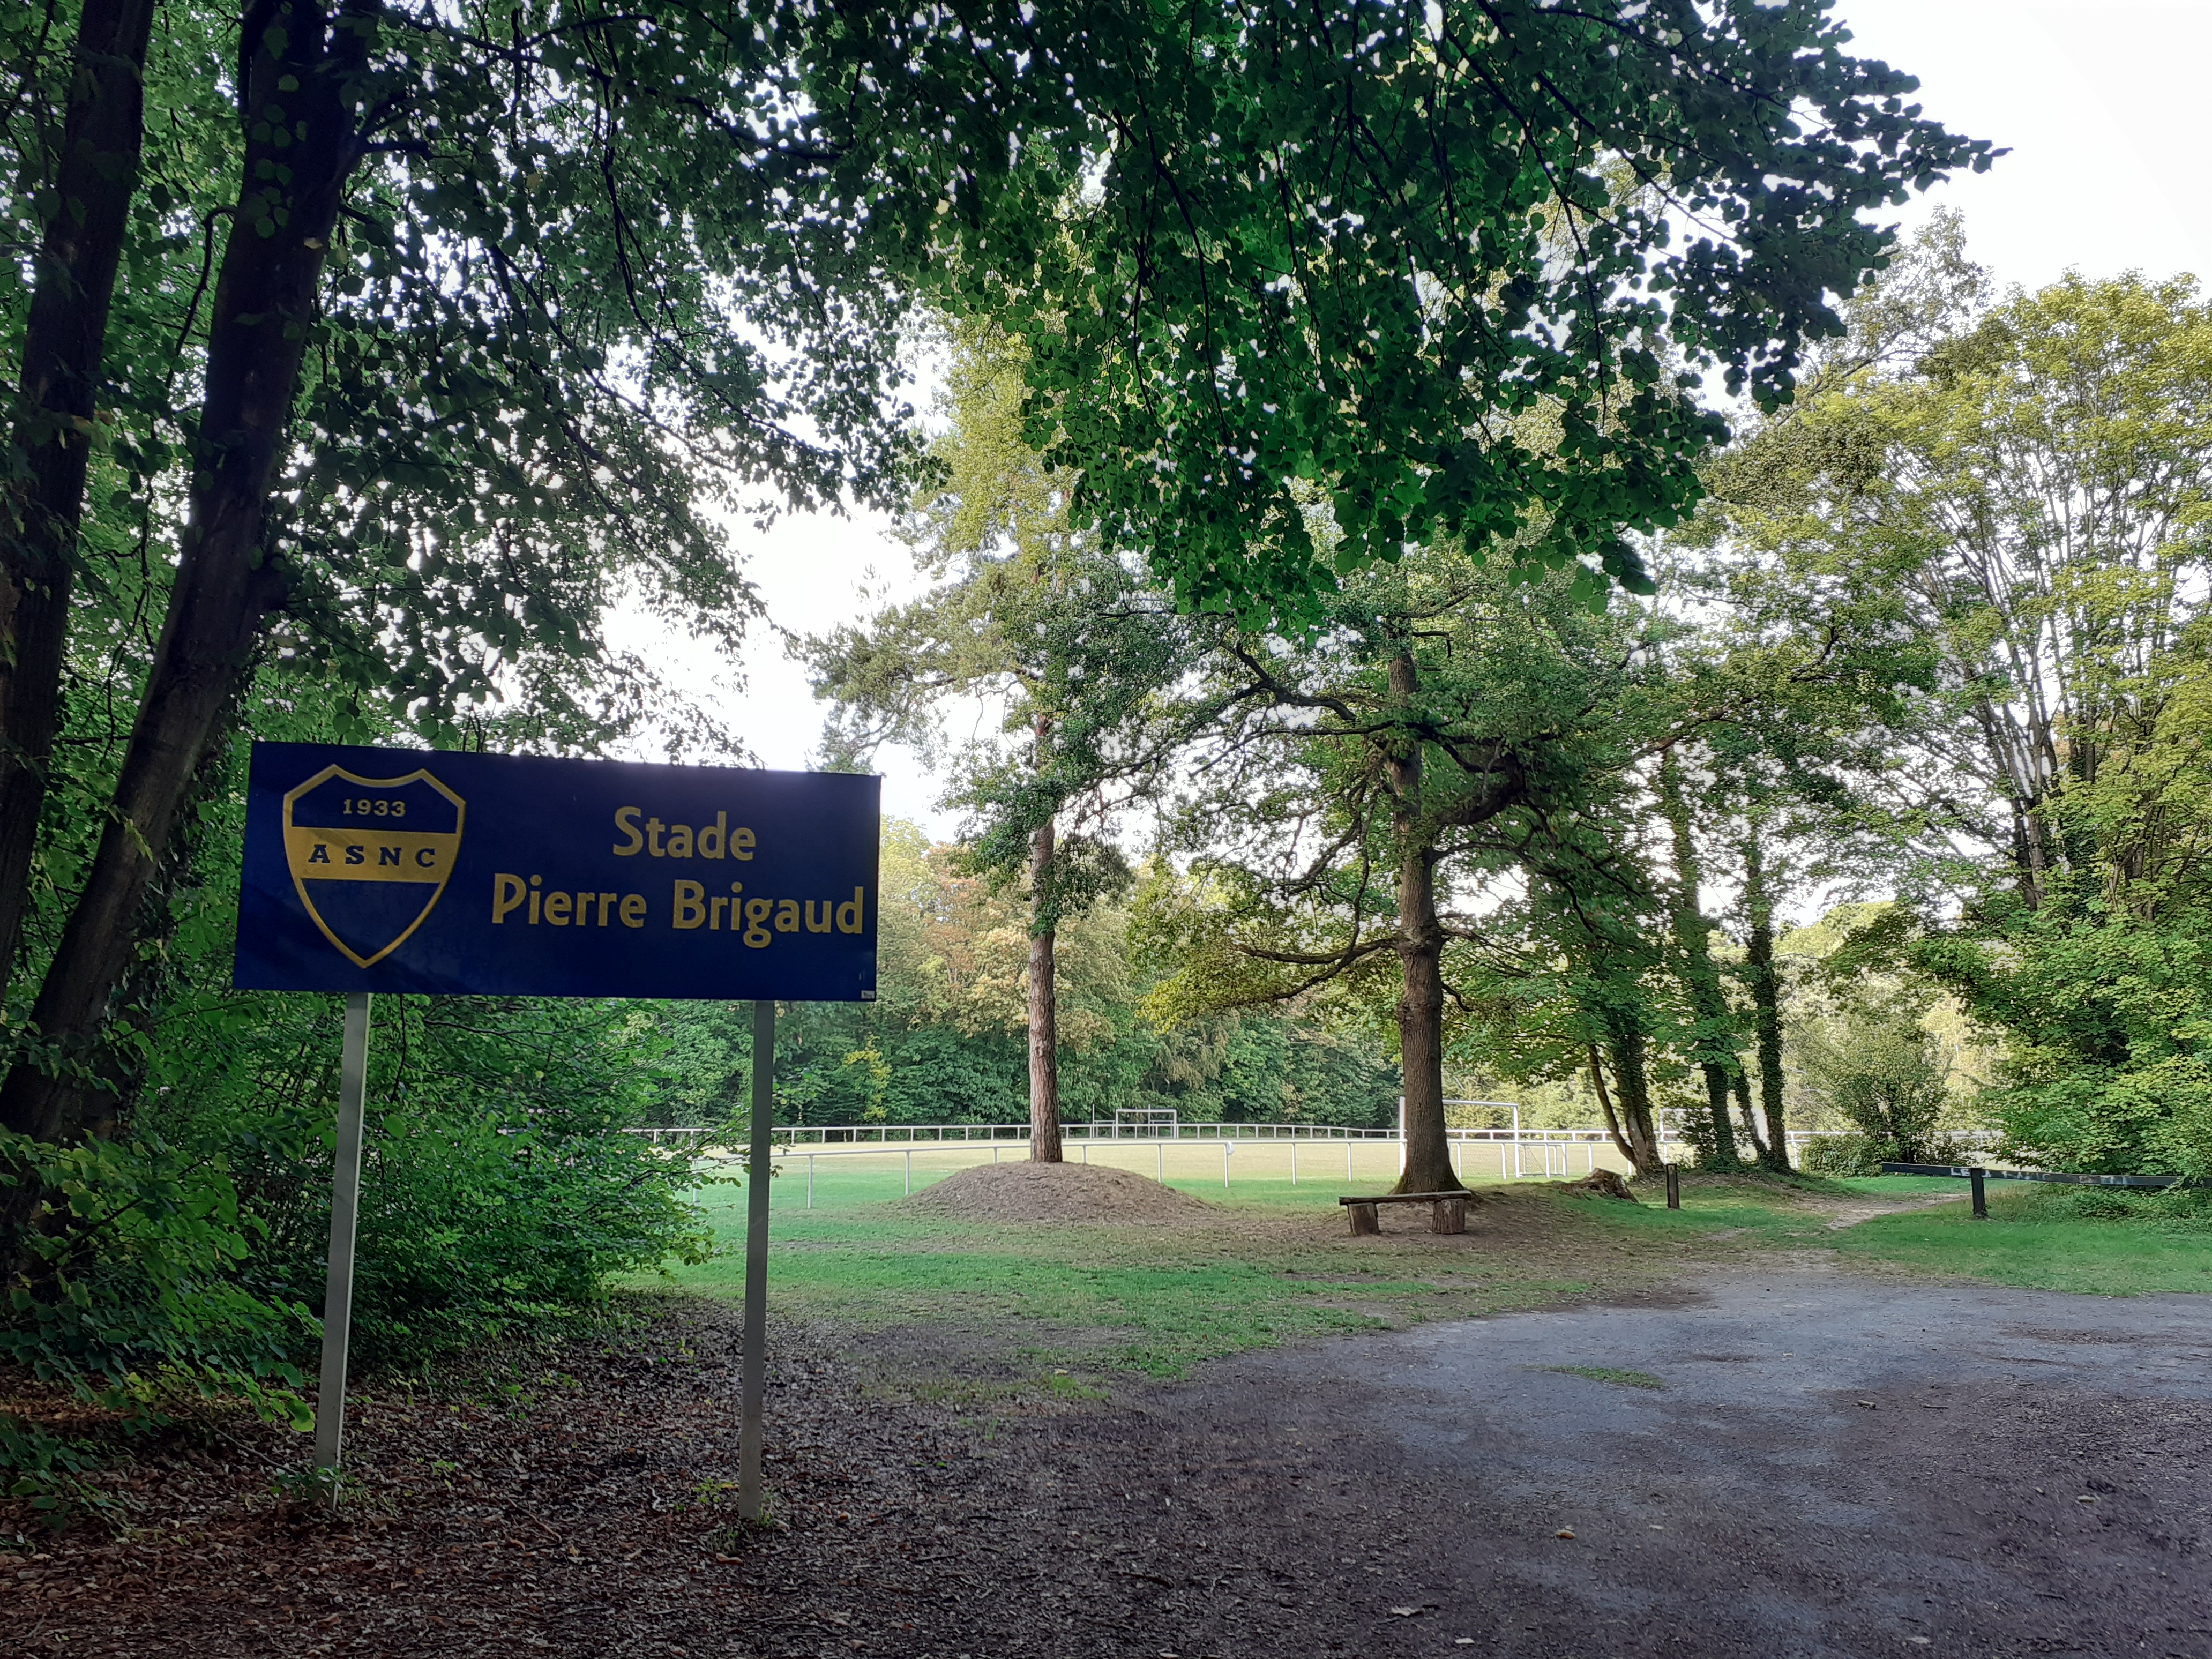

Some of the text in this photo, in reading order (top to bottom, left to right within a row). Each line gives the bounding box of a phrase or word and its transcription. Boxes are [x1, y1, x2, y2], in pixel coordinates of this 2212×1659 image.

[343, 798, 406, 818] 1933
[612, 806, 757, 861] Stade
[491, 873, 864, 948] Pierre Brigaud
